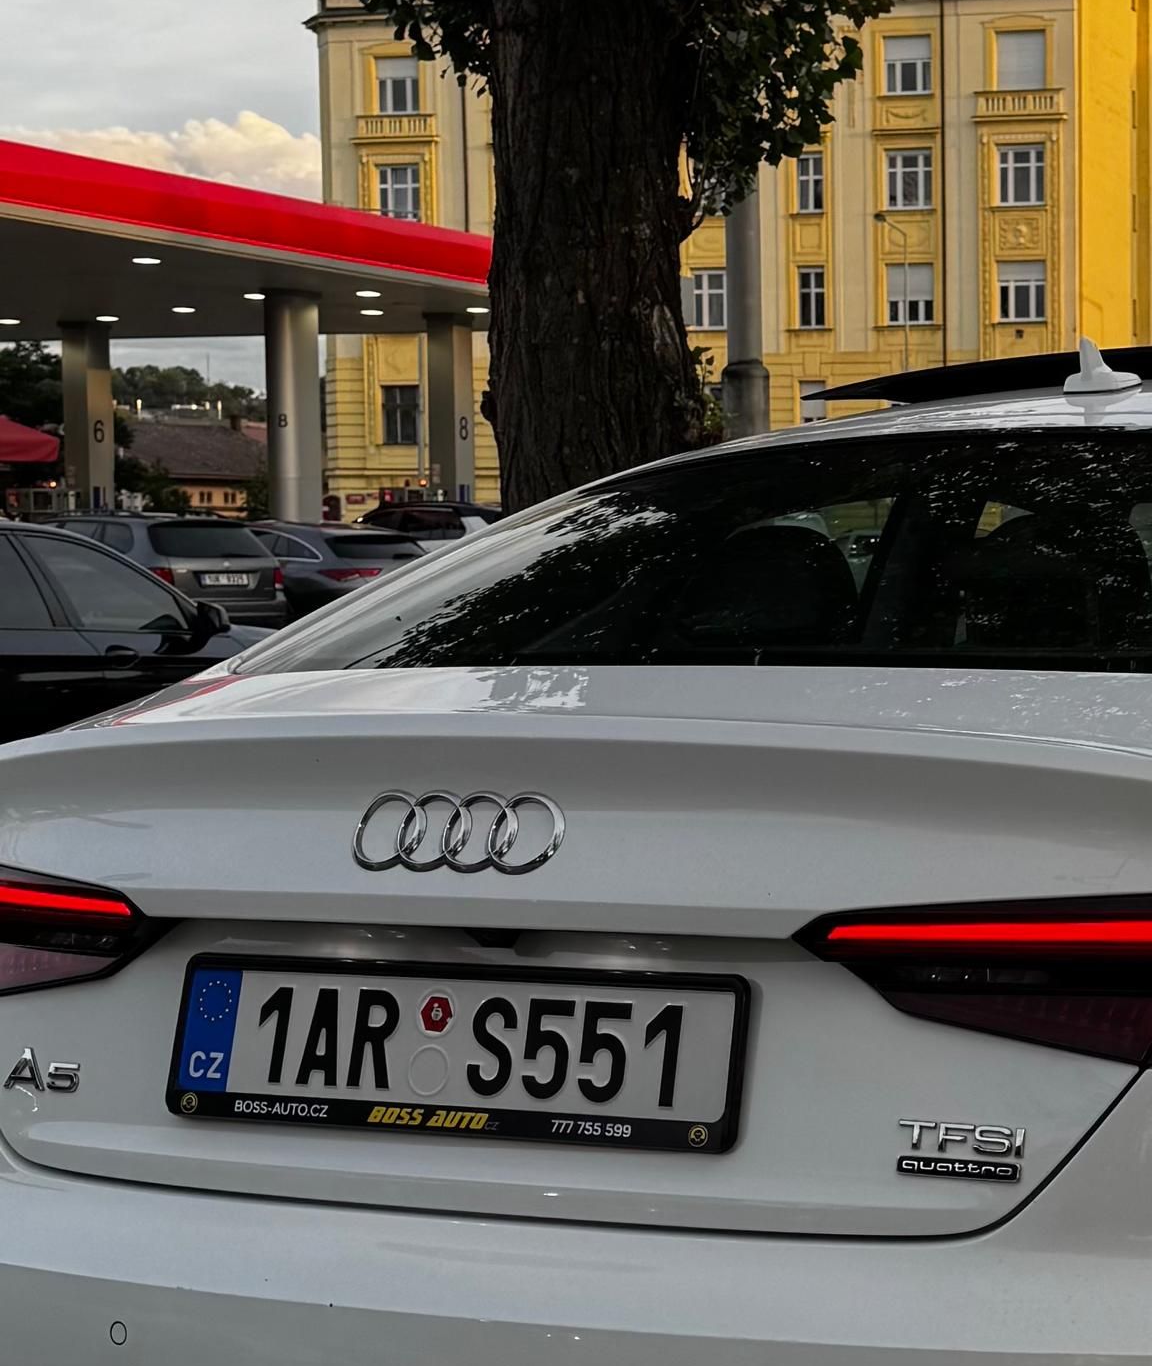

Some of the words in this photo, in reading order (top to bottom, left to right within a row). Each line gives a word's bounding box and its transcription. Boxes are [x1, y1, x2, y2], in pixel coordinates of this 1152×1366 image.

[93, 419, 105, 443] 6
[459, 416, 468, 440] 8
[258, 986, 401, 1091] 1AR
[466, 996, 684, 1108] S551
[3, 1047, 80, 1093] A5
[188, 1051, 224, 1079] CZ
[234, 1100, 328, 1117] BOSS-AUTO.CZ
[367, 1106, 424, 1125] BOSS
[425, 1110, 489, 1129] AUTO
[551, 1119, 574, 1134] 777
[576, 1120, 601, 1135] 755
[605, 1123, 632, 1138] 599
[899, 1119, 1025, 1158] TFSI
[902, 1160, 1013, 1176] quattro
